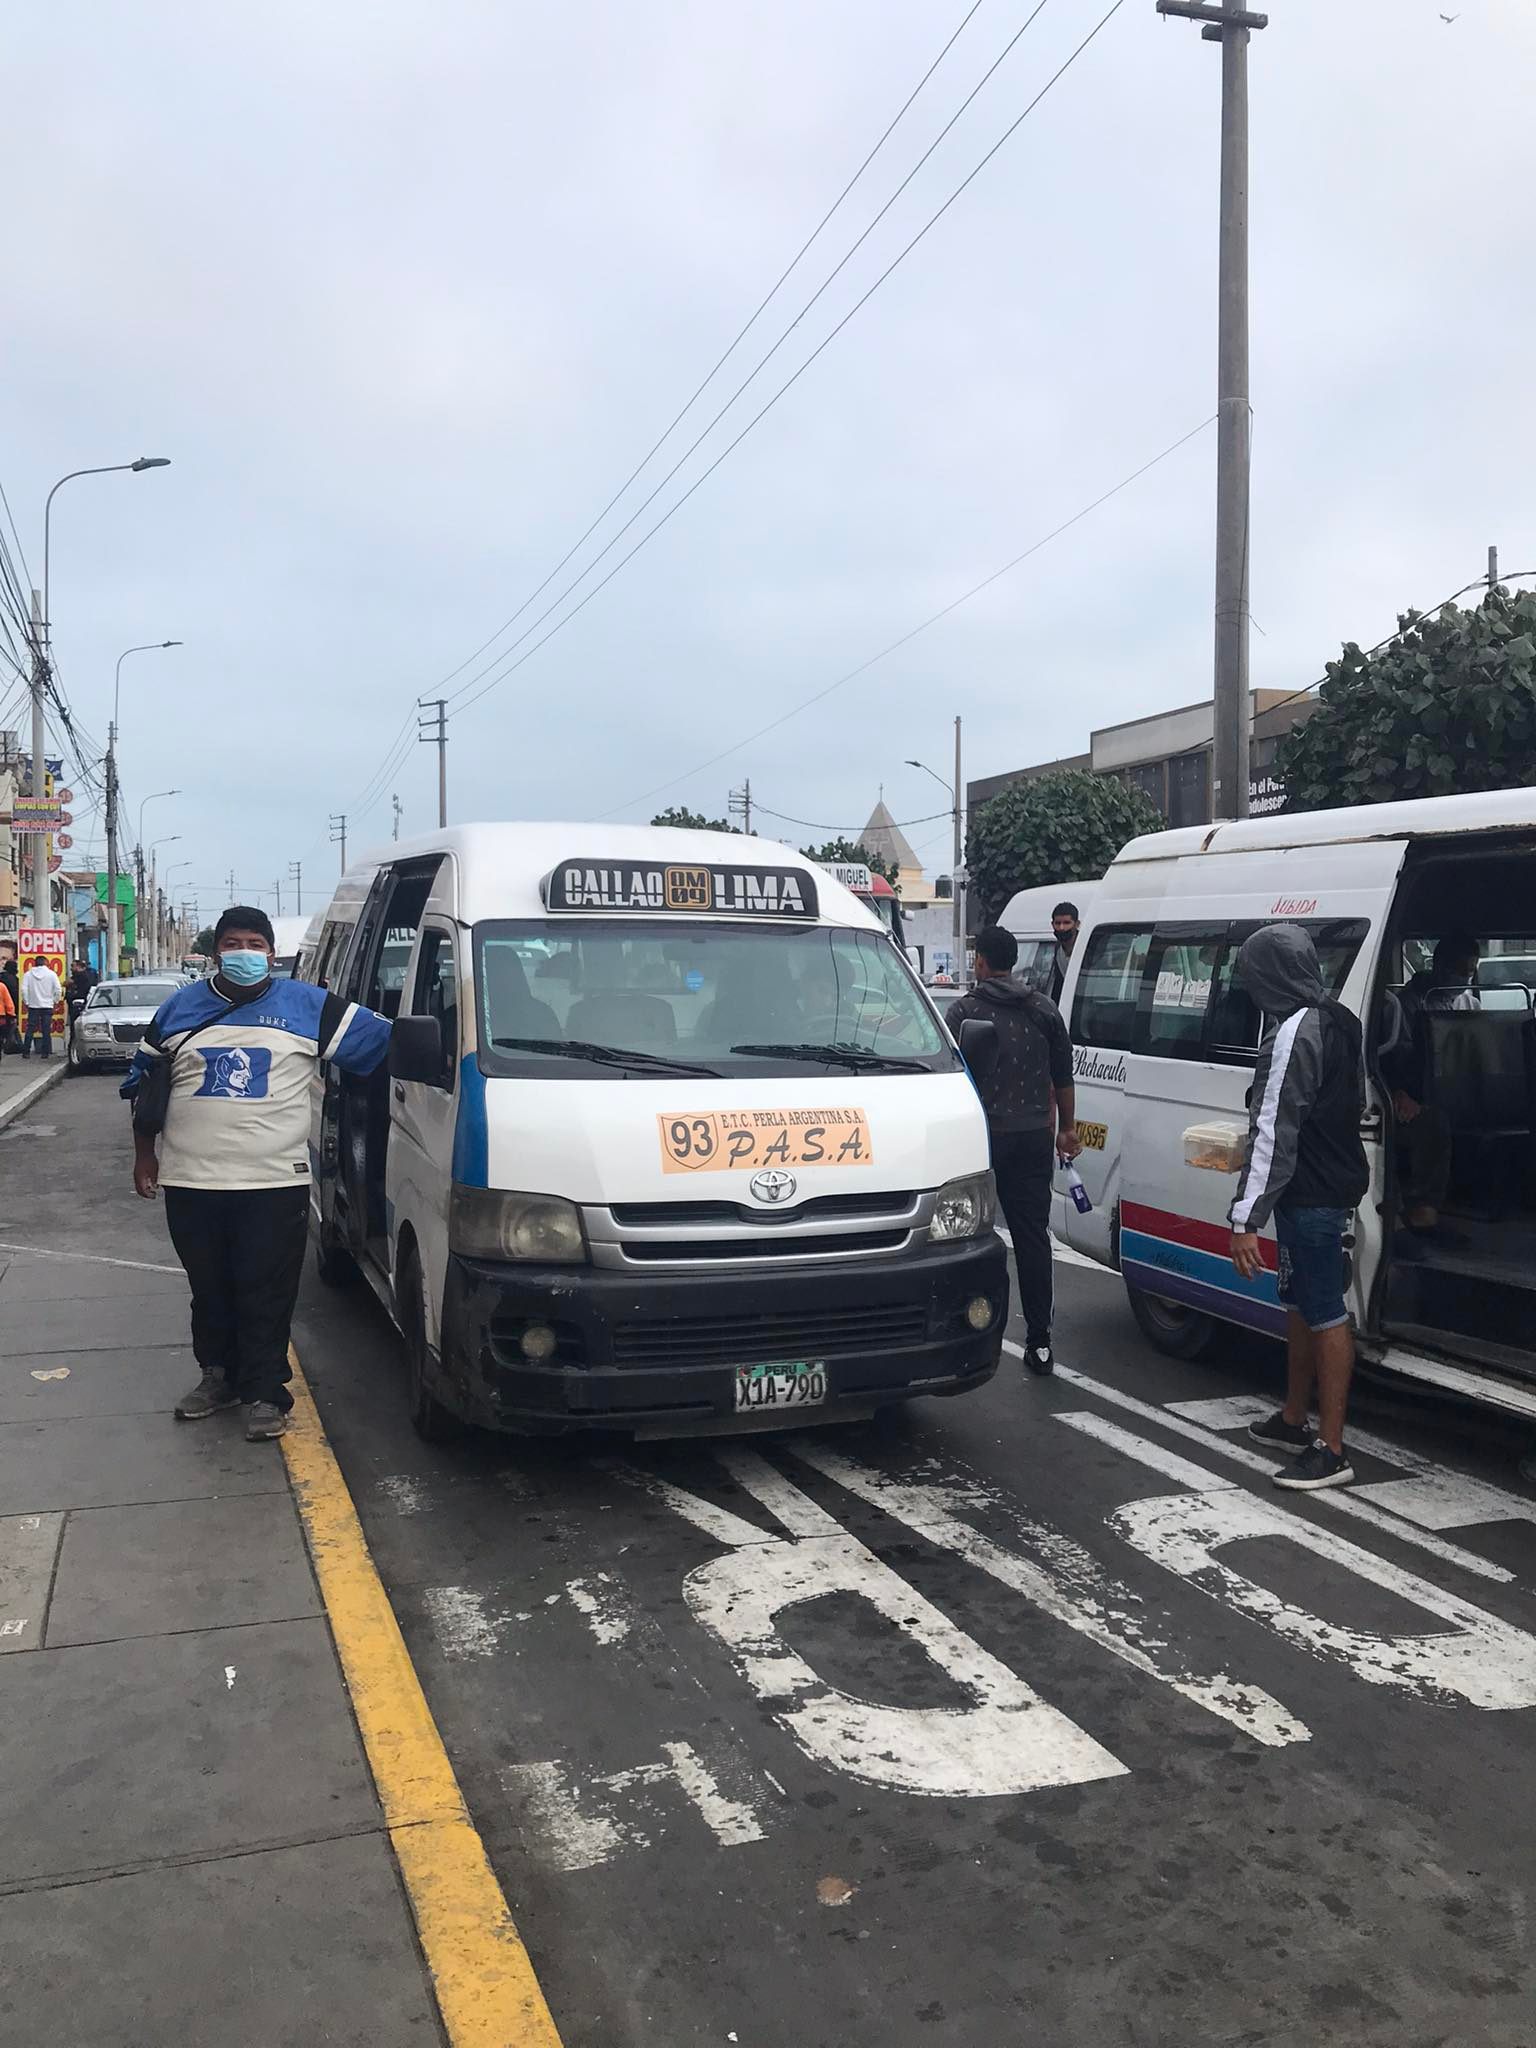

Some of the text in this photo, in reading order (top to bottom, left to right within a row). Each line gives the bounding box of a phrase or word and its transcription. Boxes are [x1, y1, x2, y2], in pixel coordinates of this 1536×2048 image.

[565, 868, 664, 907] CALLAO
[836, 868, 869, 886] MIGUEL
[671, 887, 706, 905] 09
[714, 873, 806, 912] LIMA
[20, 932, 65, 953] OPEN
[259, 1015, 287, 1027] DUKE
[721, 1109, 864, 1129] E.T.C. PERLA ARGENTINA S.A.
[671, 1119, 713, 1159] 93
[727, 1127, 871, 1168] P.A.S.A.
[738, 1374, 824, 1407] X1A-790
